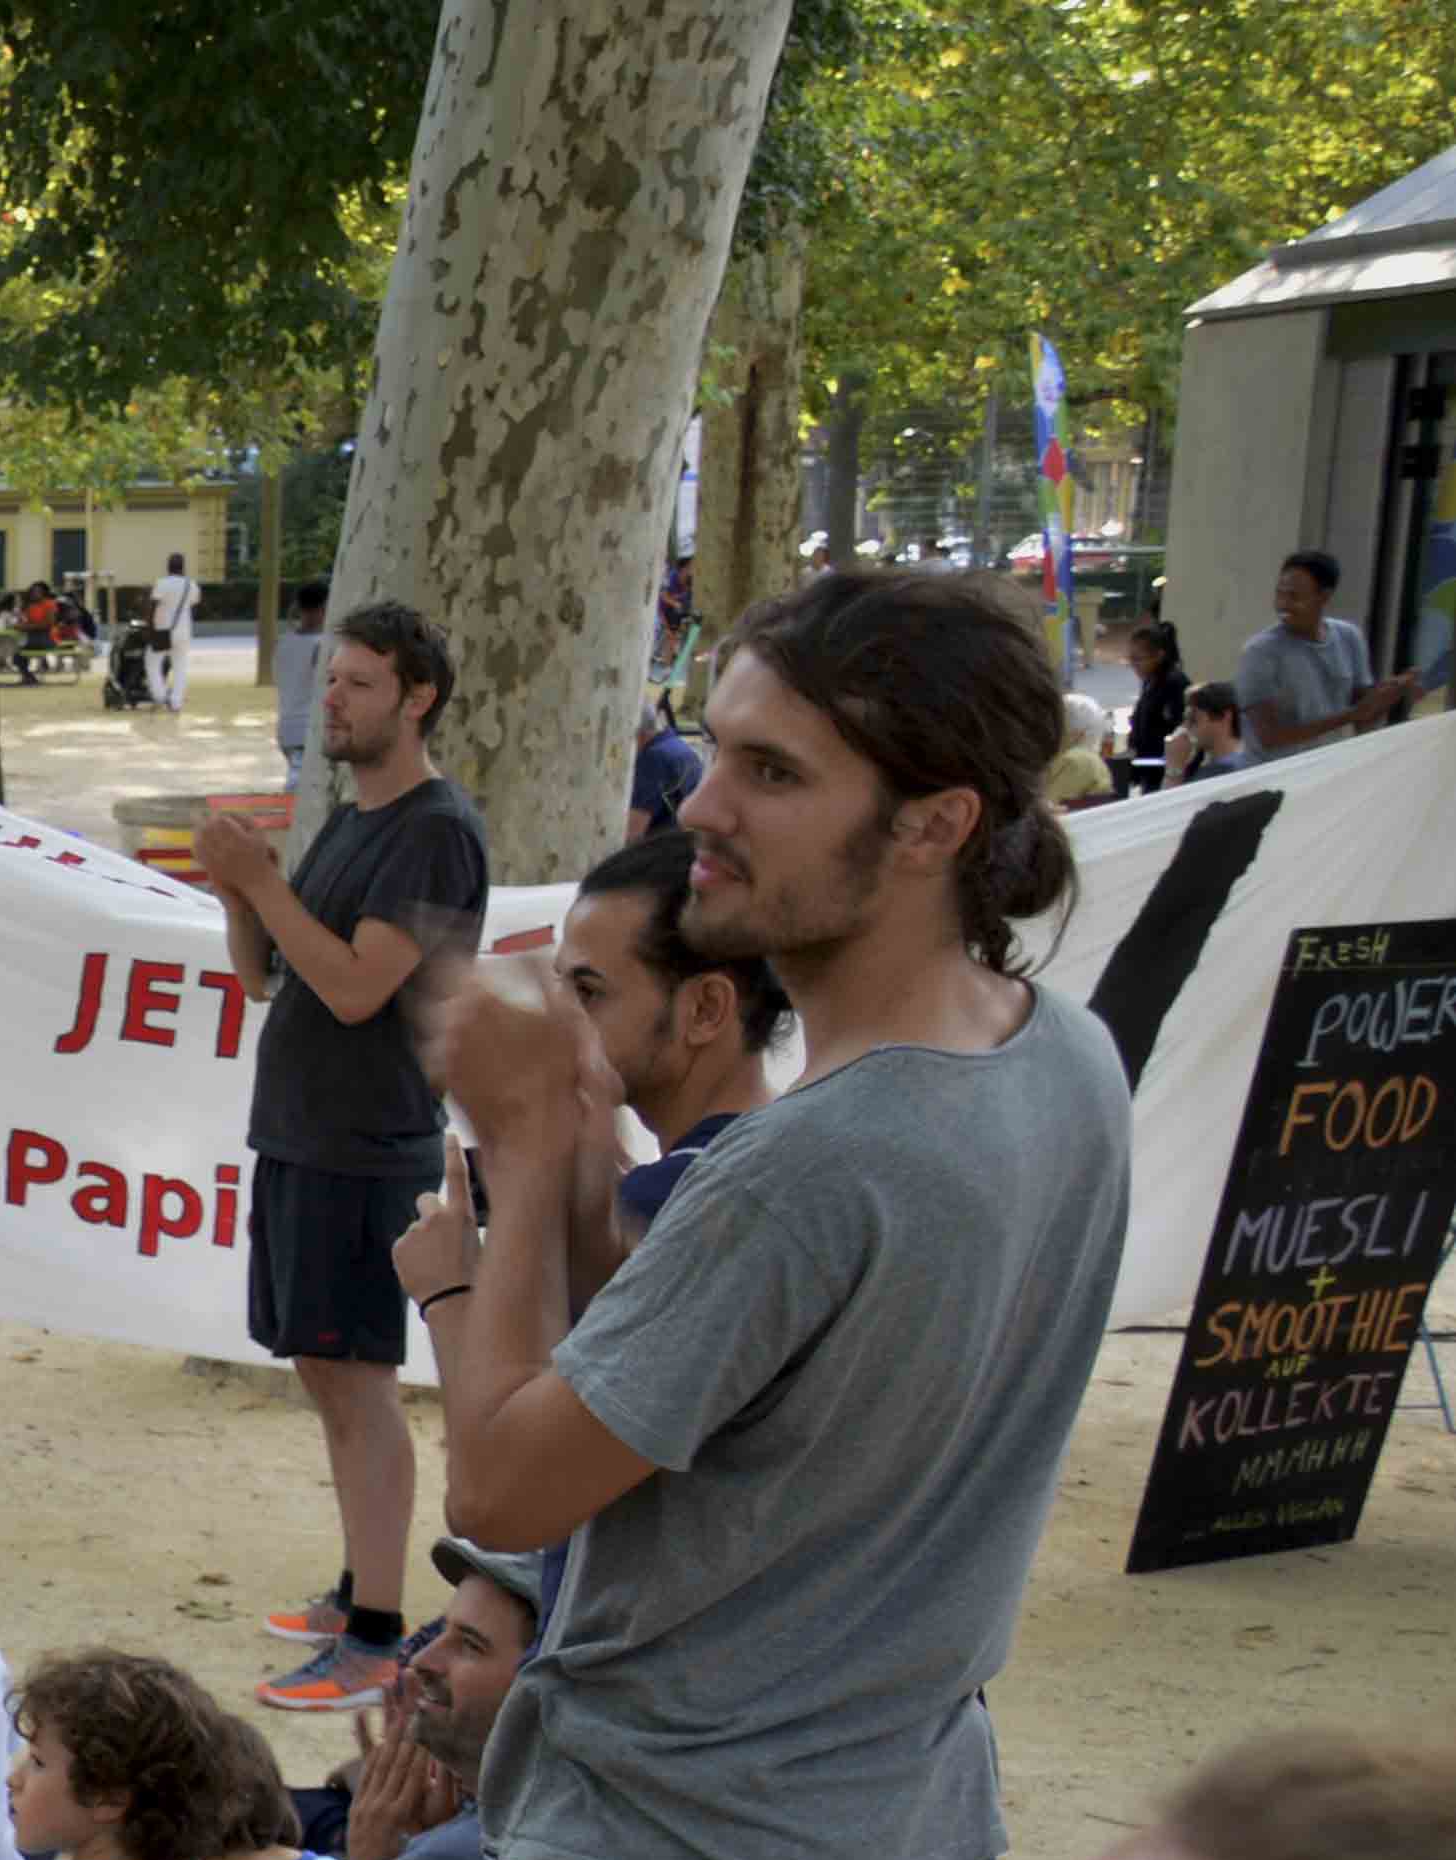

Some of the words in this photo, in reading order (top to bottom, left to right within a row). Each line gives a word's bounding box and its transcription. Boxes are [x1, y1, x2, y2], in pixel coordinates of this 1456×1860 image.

[1293, 927, 1391, 980] FRESH
[1279, 1075, 1438, 1158] FOOD
[1222, 1189, 1429, 1275] MUESLI
[1193, 1282, 1427, 1367] SMOOTHIE
[1264, 1353, 1312, 1379] AUF
[1178, 1371, 1396, 1449] KOLLEKTE
